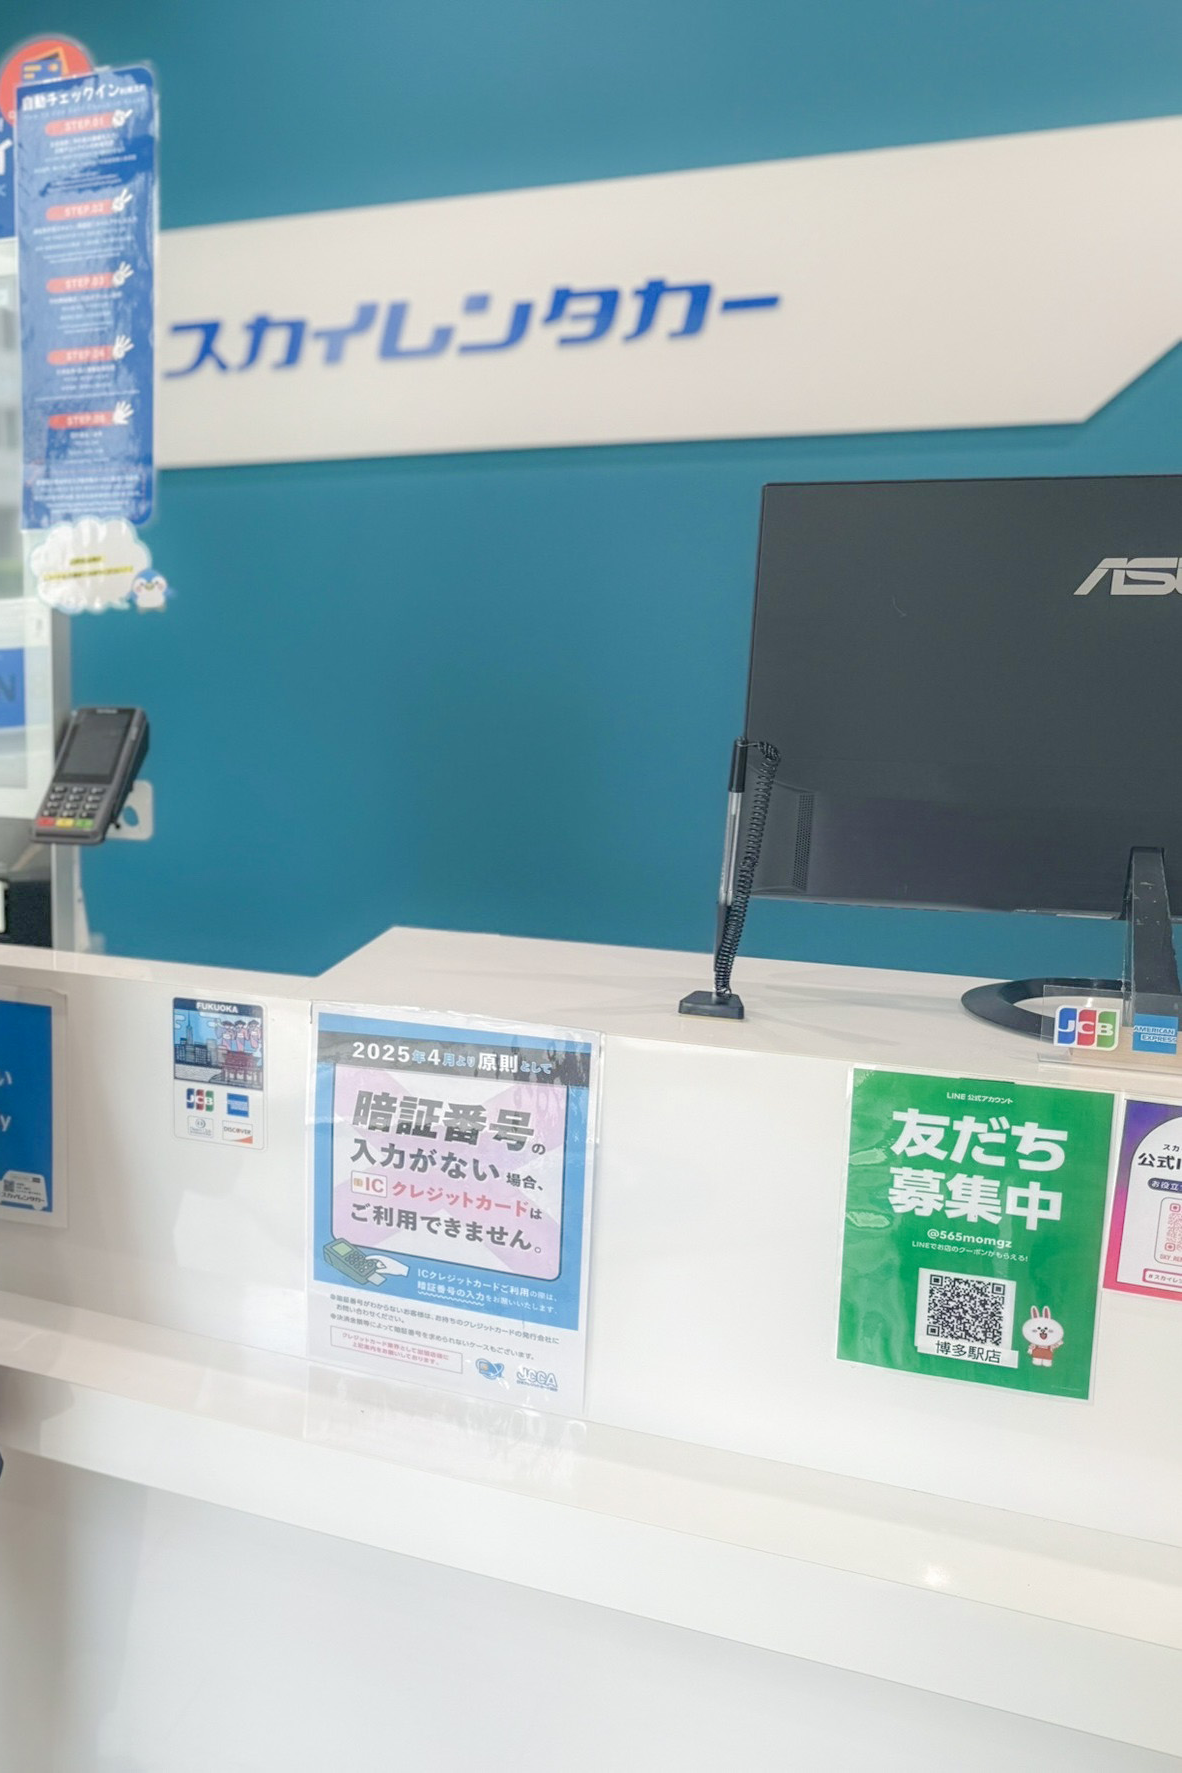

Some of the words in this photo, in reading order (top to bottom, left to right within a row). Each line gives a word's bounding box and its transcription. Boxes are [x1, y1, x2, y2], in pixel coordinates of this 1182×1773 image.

[163, 279, 780, 379] スカイレンタカー
[1073, 557, 1182, 595] AS
[196, 1001, 239, 1014] FUKUOKA
[1058, 1015, 1116, 1041] JCB
[1133, 1025, 1175, 1035] AMERICAN
[946, 1092, 966, 1100] LINE
[967, 1094, 1014, 1105] 公式アカウント
[352, 1090, 546, 1156] 暗証番号の
[890, 1107, 1068, 1172] 友だち
[350, 1138, 544, 1192] 入力がない場合、
[365, 1176, 384, 1194] IC
[392, 1181, 542, 1221] クレジットカードは
[887, 1166, 1063, 1231] 募集中
[350, 1203, 542, 1254] ご利用できません。
[927, 1228, 1012, 1249] @565momgz
[935, 1340, 1002, 1364] 博多駅店
